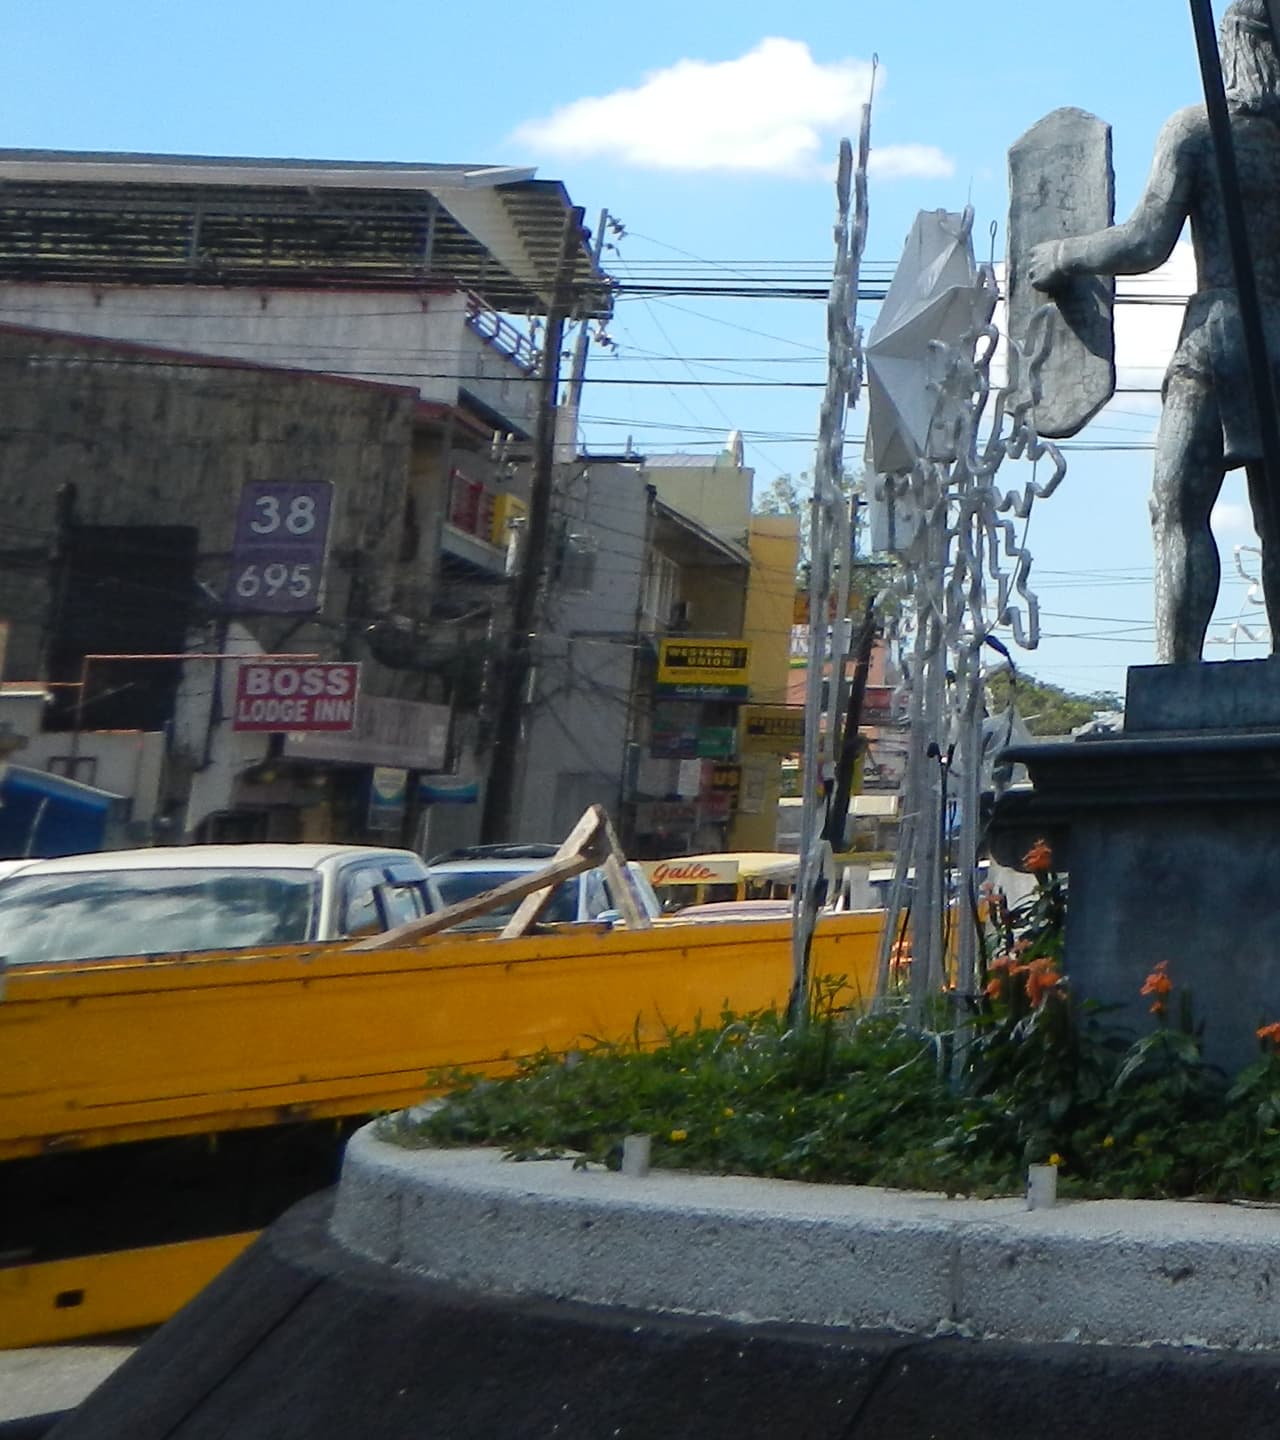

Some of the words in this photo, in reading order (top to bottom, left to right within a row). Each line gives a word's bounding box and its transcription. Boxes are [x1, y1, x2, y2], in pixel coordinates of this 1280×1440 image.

[250, 495, 316, 535] 38
[236, 563, 311, 598] 695
[246, 667, 351, 696] BOSS
[238, 700, 309, 722] LODGE
[313, 699, 352, 721] INN
